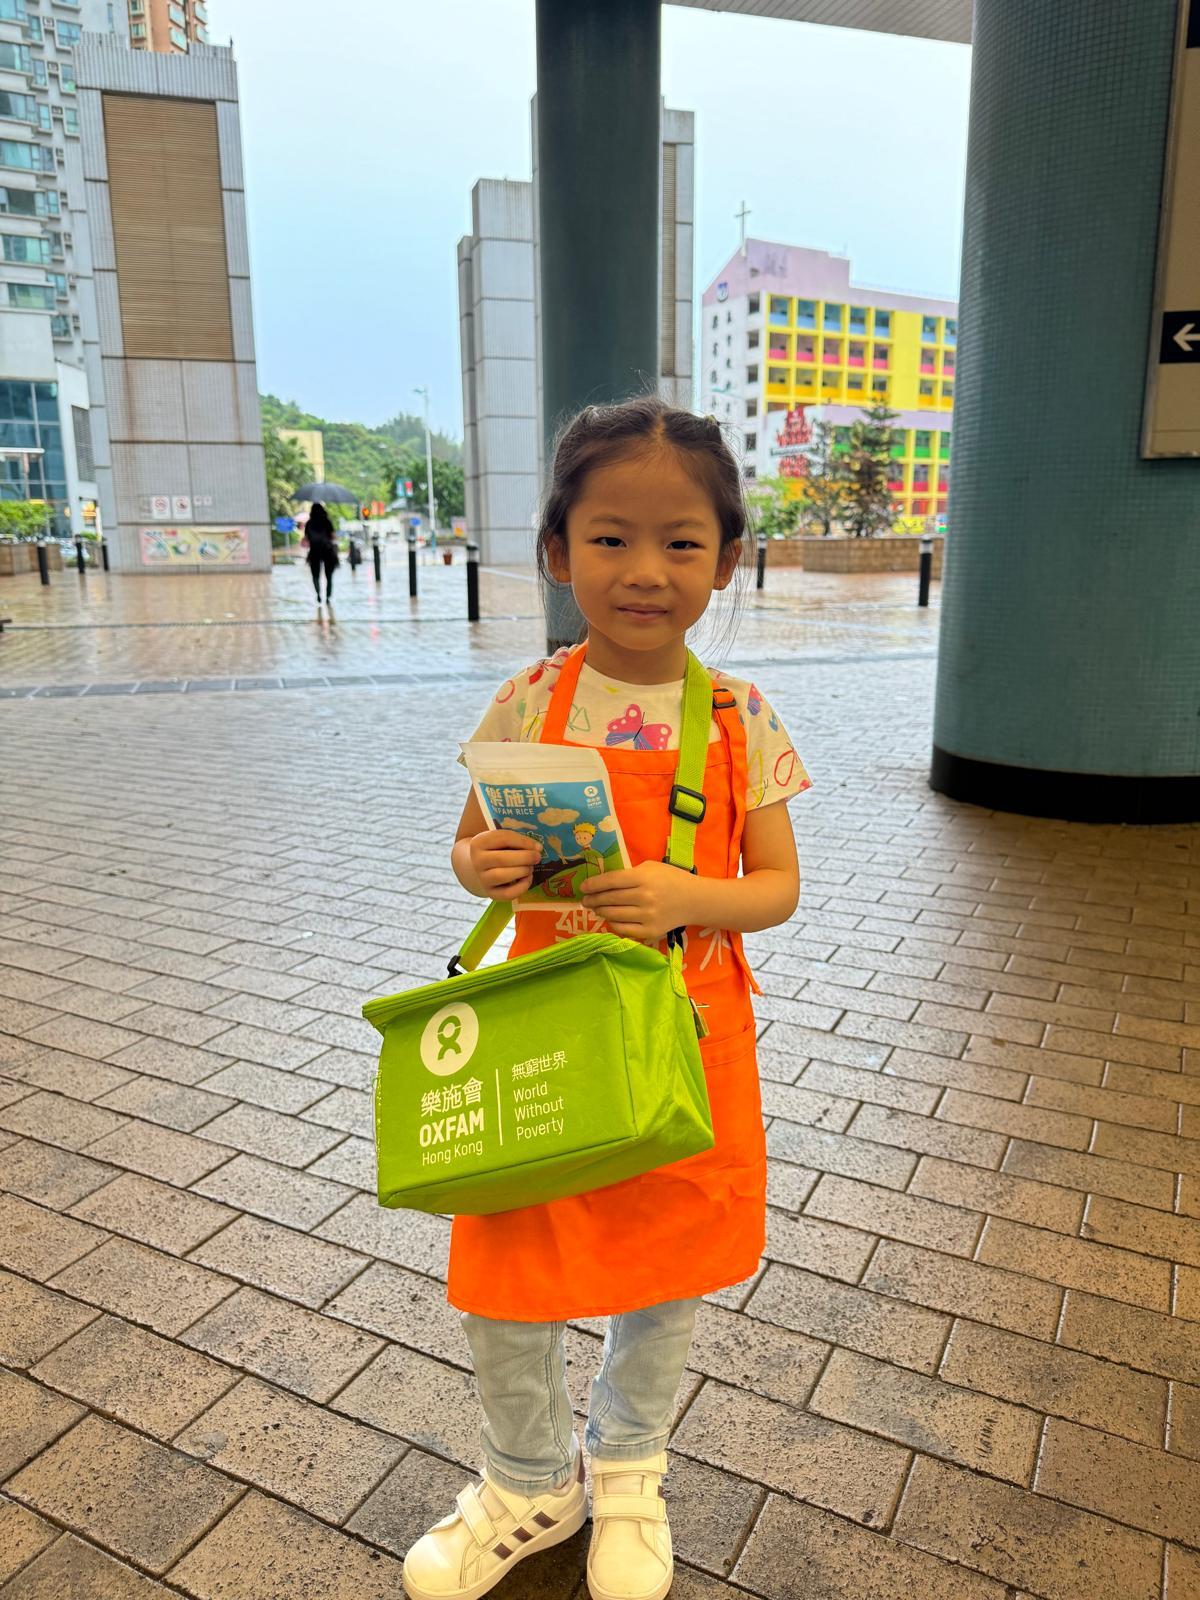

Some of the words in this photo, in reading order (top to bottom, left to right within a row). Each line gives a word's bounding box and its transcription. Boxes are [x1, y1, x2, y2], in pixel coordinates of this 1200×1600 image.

[486, 787, 548, 808] 樂施米
[512, 1051, 568, 1082] 無窮世界
[421, 1076, 483, 1117] 樂施會
[513, 1081, 548, 1103] World
[514, 1096, 564, 1122] Without
[419, 1107, 485, 1148] OXFAM
[516, 1117, 564, 1141] Poverty
[422, 1149, 451, 1166] Hong
[454, 1140, 483, 1158] Kong
